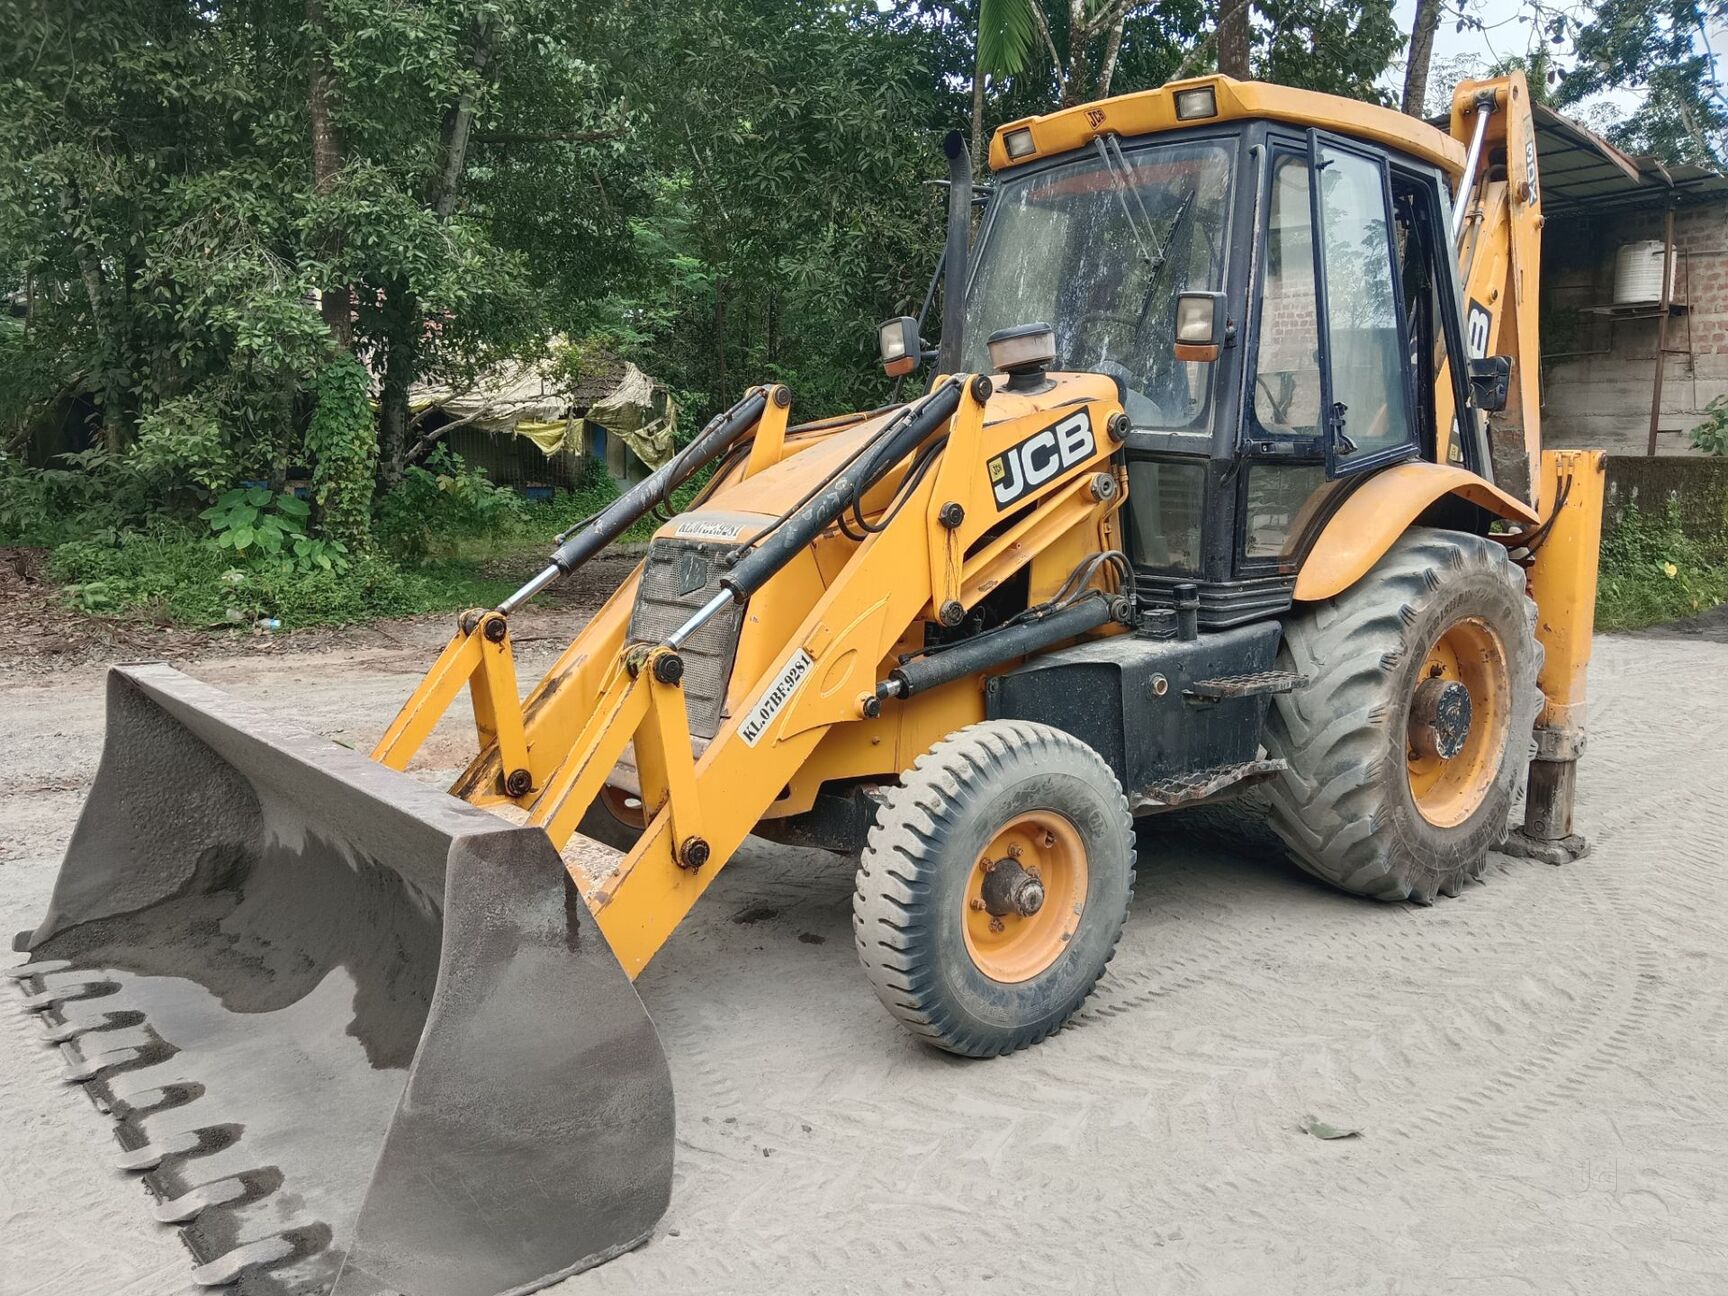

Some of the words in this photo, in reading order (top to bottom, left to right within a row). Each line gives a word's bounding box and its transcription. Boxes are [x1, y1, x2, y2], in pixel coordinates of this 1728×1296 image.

[1087, 110, 1105, 127] JCB
[994, 412, 1094, 503] JCB
[742, 654, 811, 742] KL.07BF.9281
